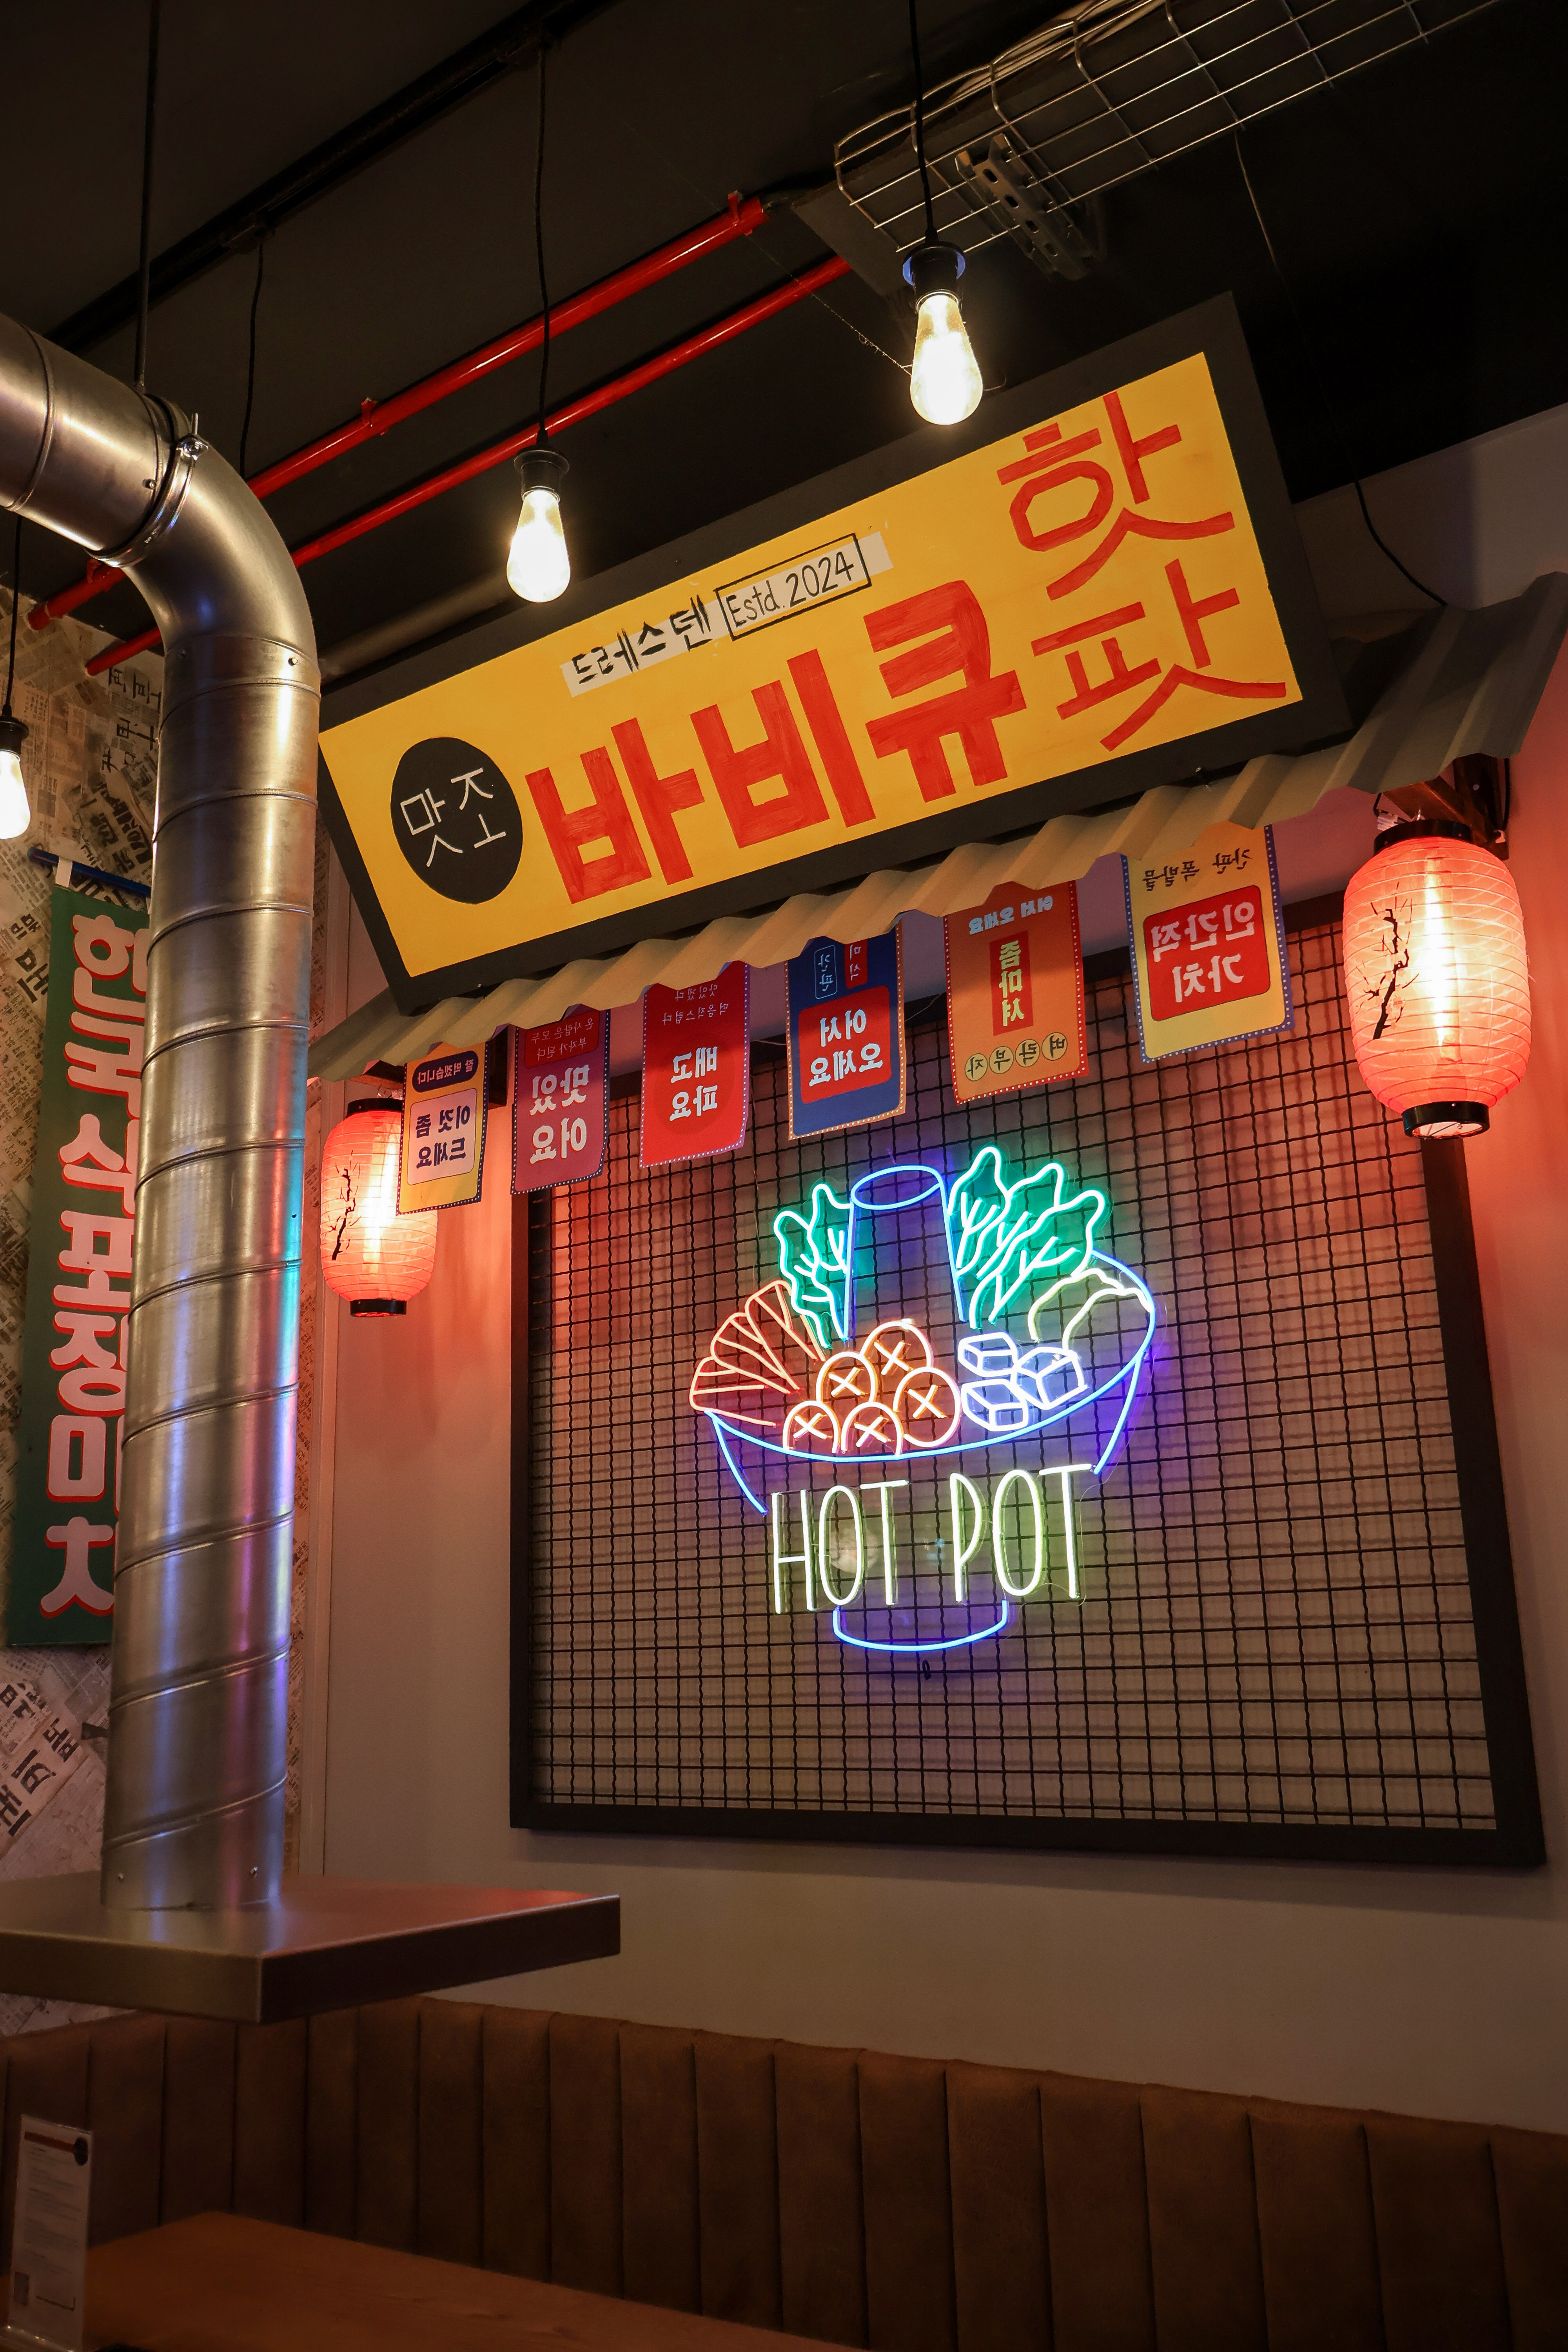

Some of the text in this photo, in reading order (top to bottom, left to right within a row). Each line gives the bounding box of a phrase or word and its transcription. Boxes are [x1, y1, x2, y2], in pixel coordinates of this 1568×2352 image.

[571, 594, 713, 684] 드레스덴
[726, 551, 854, 628] Estd. 2024
[524, 580, 1027, 904] 바비큐
[771, 1463, 1093, 1615] HOT POT
